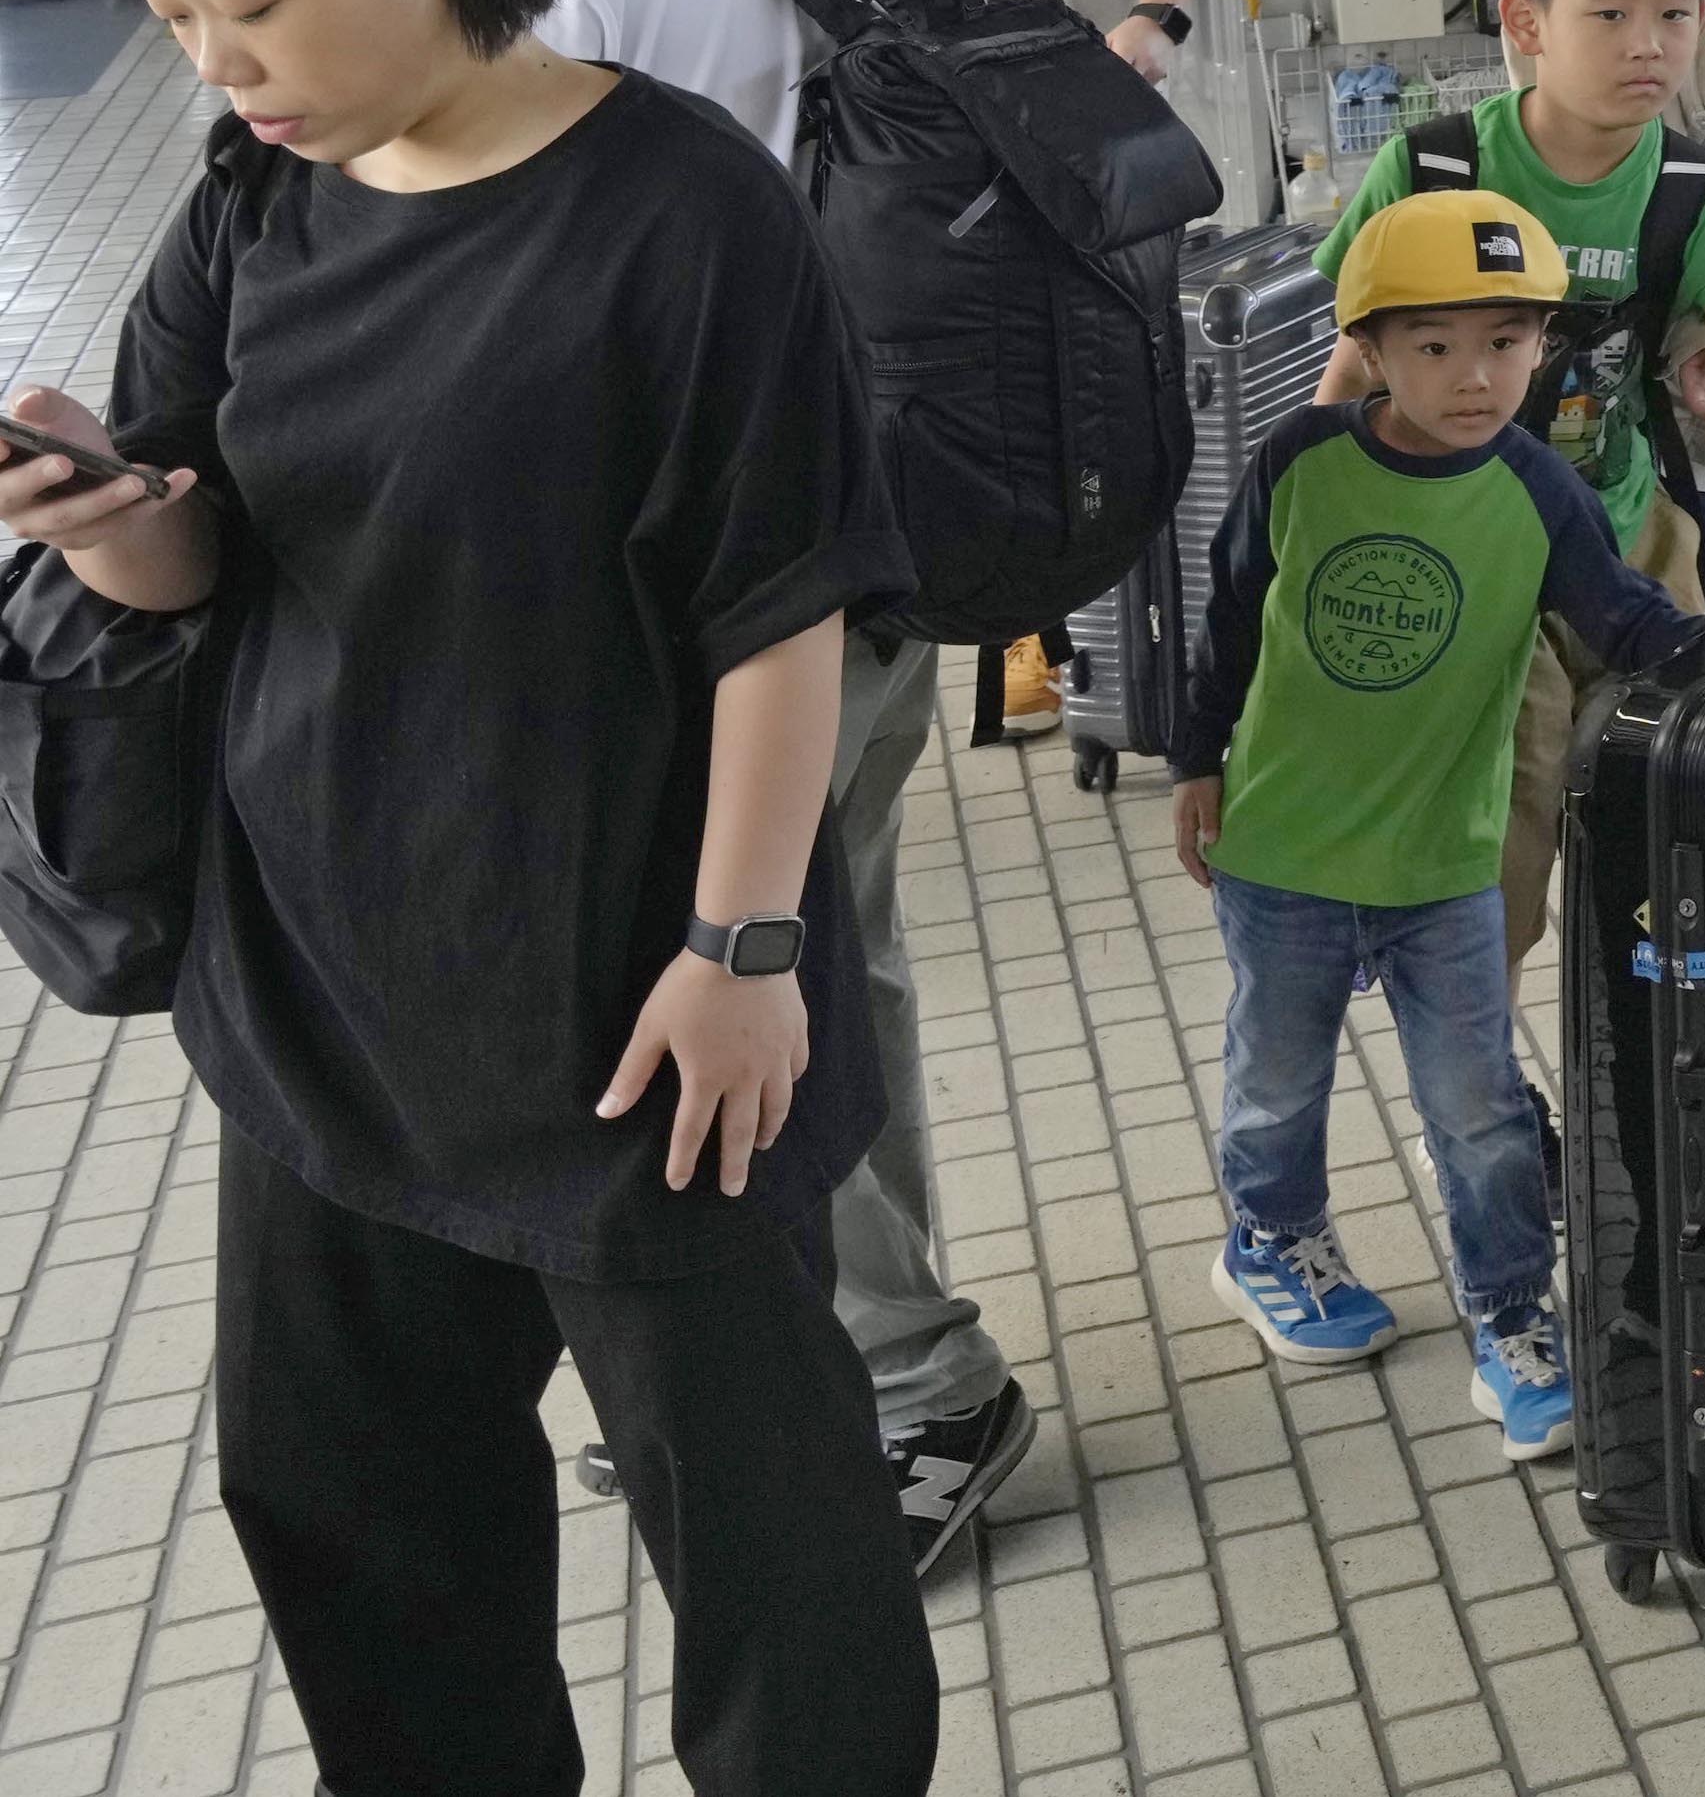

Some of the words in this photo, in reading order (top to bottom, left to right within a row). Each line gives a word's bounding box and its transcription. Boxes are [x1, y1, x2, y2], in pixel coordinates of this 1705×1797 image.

[1327, 550, 1388, 584] FUNCTION
[1393, 551, 1407, 564] IS
[1410, 557, 1447, 600] BEAUTY
[1323, 634, 1367, 674] SINCE
